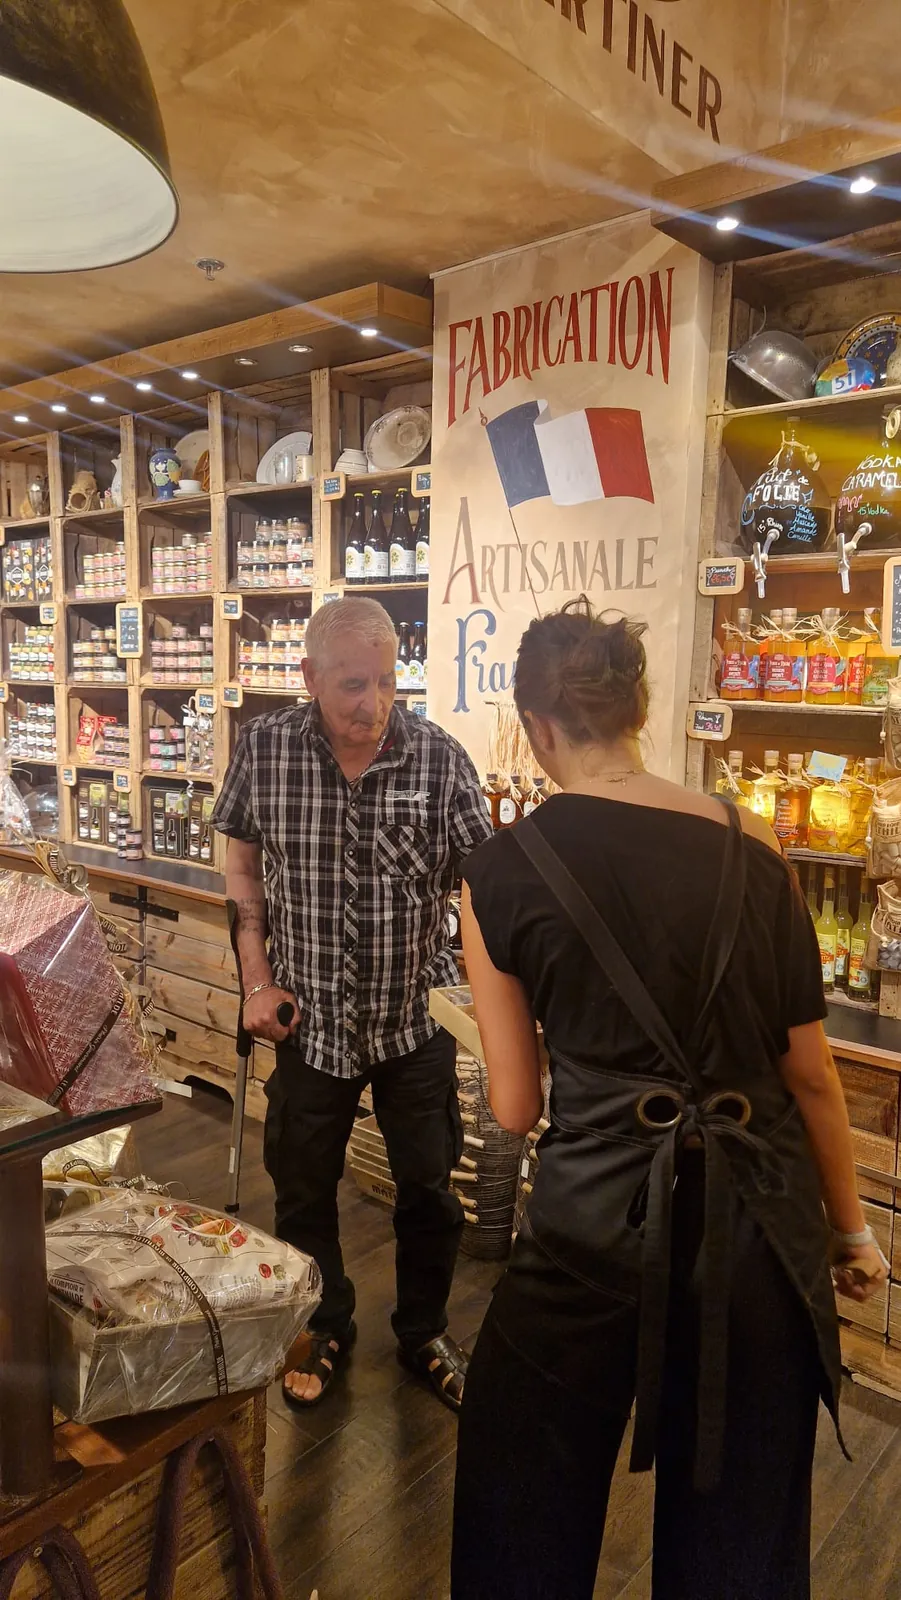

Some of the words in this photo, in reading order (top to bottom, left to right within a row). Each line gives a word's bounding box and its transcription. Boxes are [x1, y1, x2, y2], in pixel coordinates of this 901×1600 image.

[447, 267, 675, 429] FABRICATION
[835, 372, 852, 390] 51
[752, 483, 801, 502] FOLIE
[452, 609, 516, 713] Fra
[172, 1262, 199, 1294] COMPTOIR
